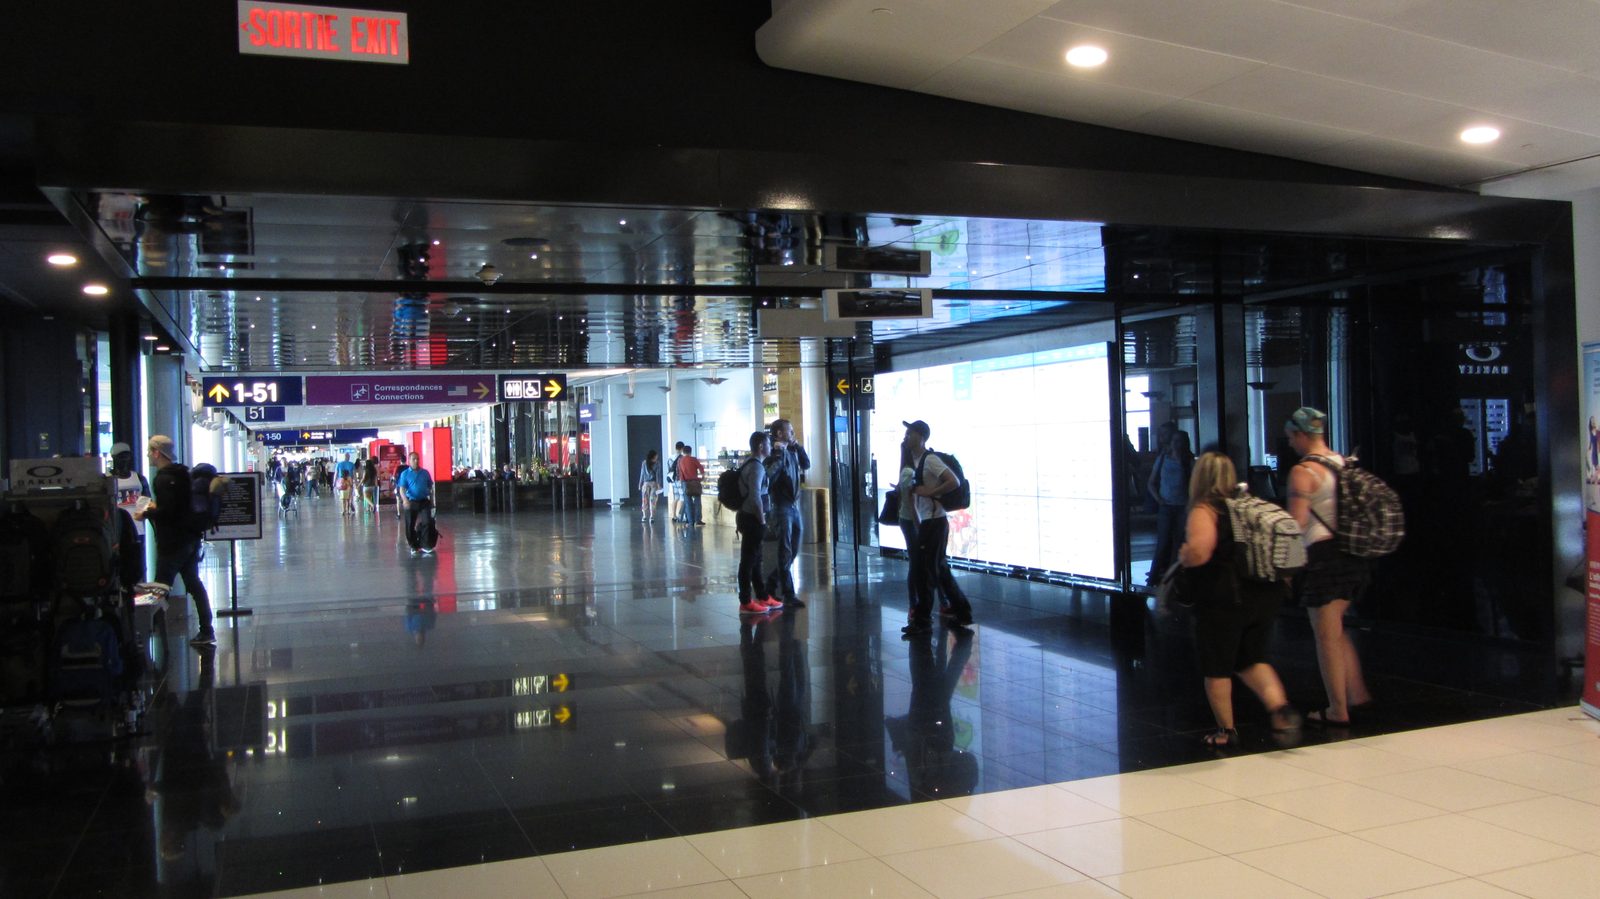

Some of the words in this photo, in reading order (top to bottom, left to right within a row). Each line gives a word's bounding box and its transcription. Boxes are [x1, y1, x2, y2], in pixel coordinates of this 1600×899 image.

[250, 8, 340, 52] SORTIE
[351, 16, 400, 56] EXIT
[233, 382, 278, 403] 1-51
[374, 384, 443, 392] Correspondances
[249, 407, 265, 420] 51
